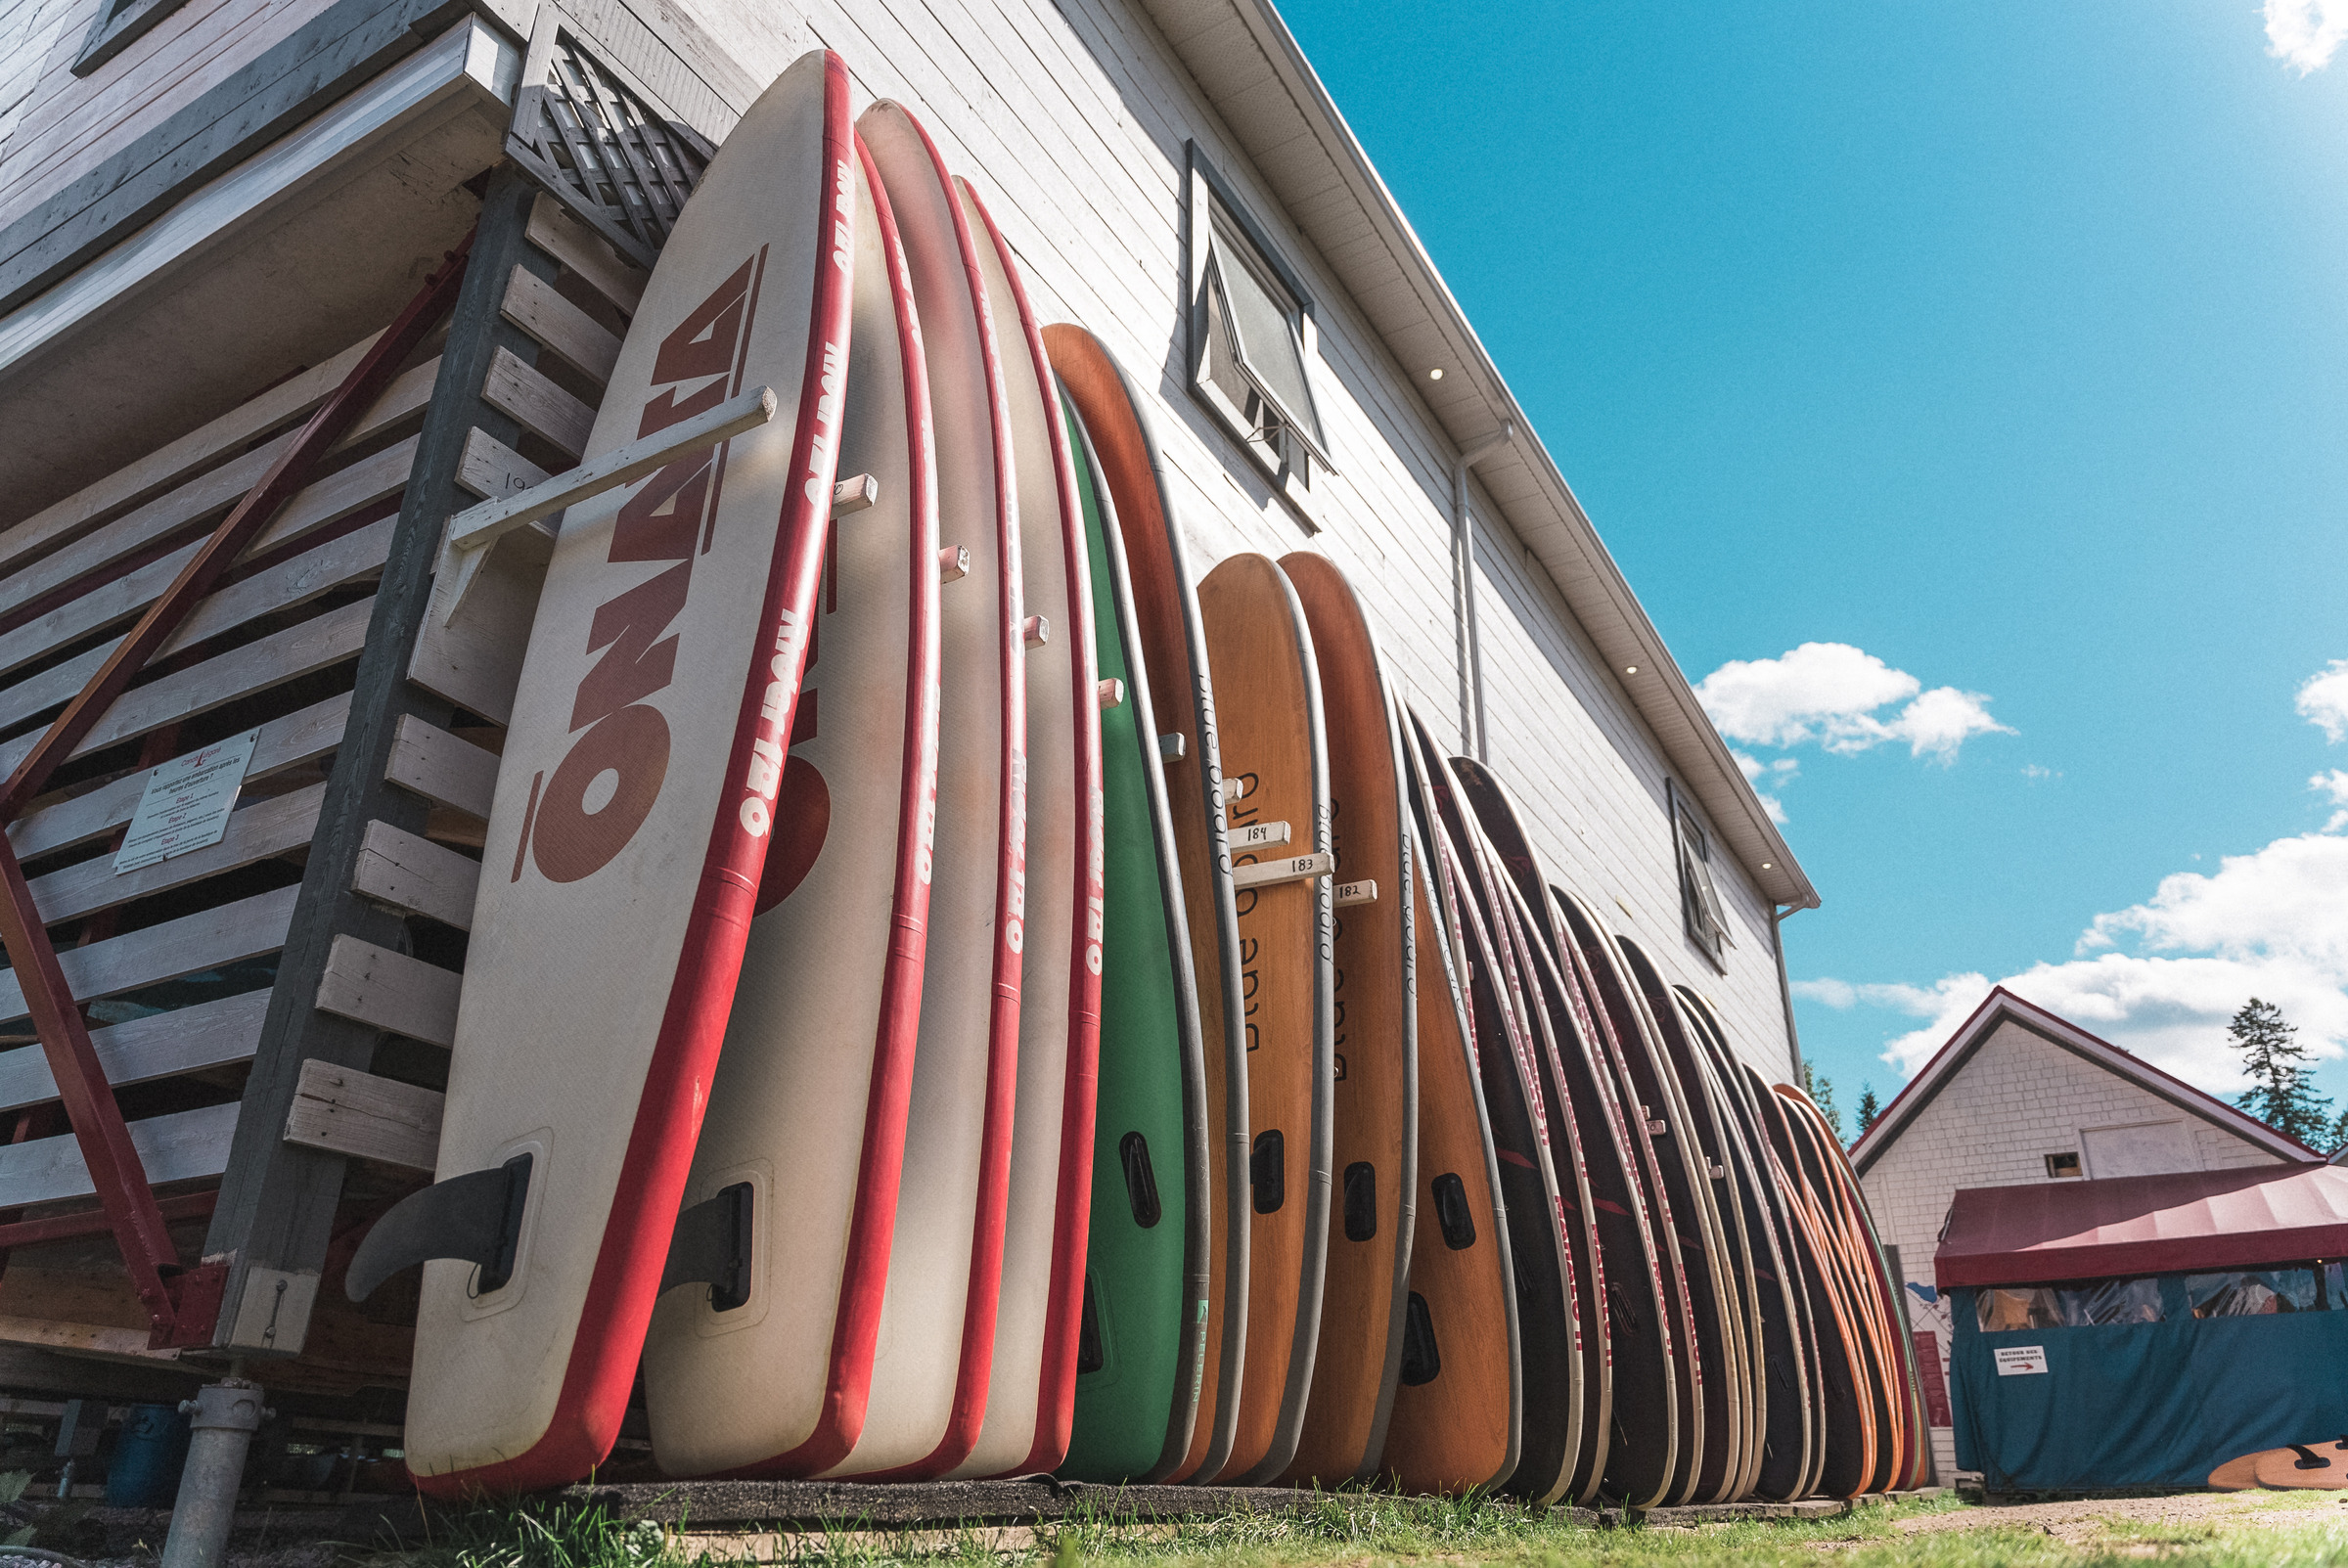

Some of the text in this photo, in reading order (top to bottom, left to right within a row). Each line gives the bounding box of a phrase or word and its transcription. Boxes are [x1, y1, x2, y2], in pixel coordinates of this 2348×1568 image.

[505, 472, 534, 490] 19
[761, 608, 808, 736] Rider
[1247, 827, 1267, 841] 184
[1291, 859, 1313, 873] 183
[1339, 885, 1361, 898] 182
[1193, 1331, 1206, 1403] PELERIN
